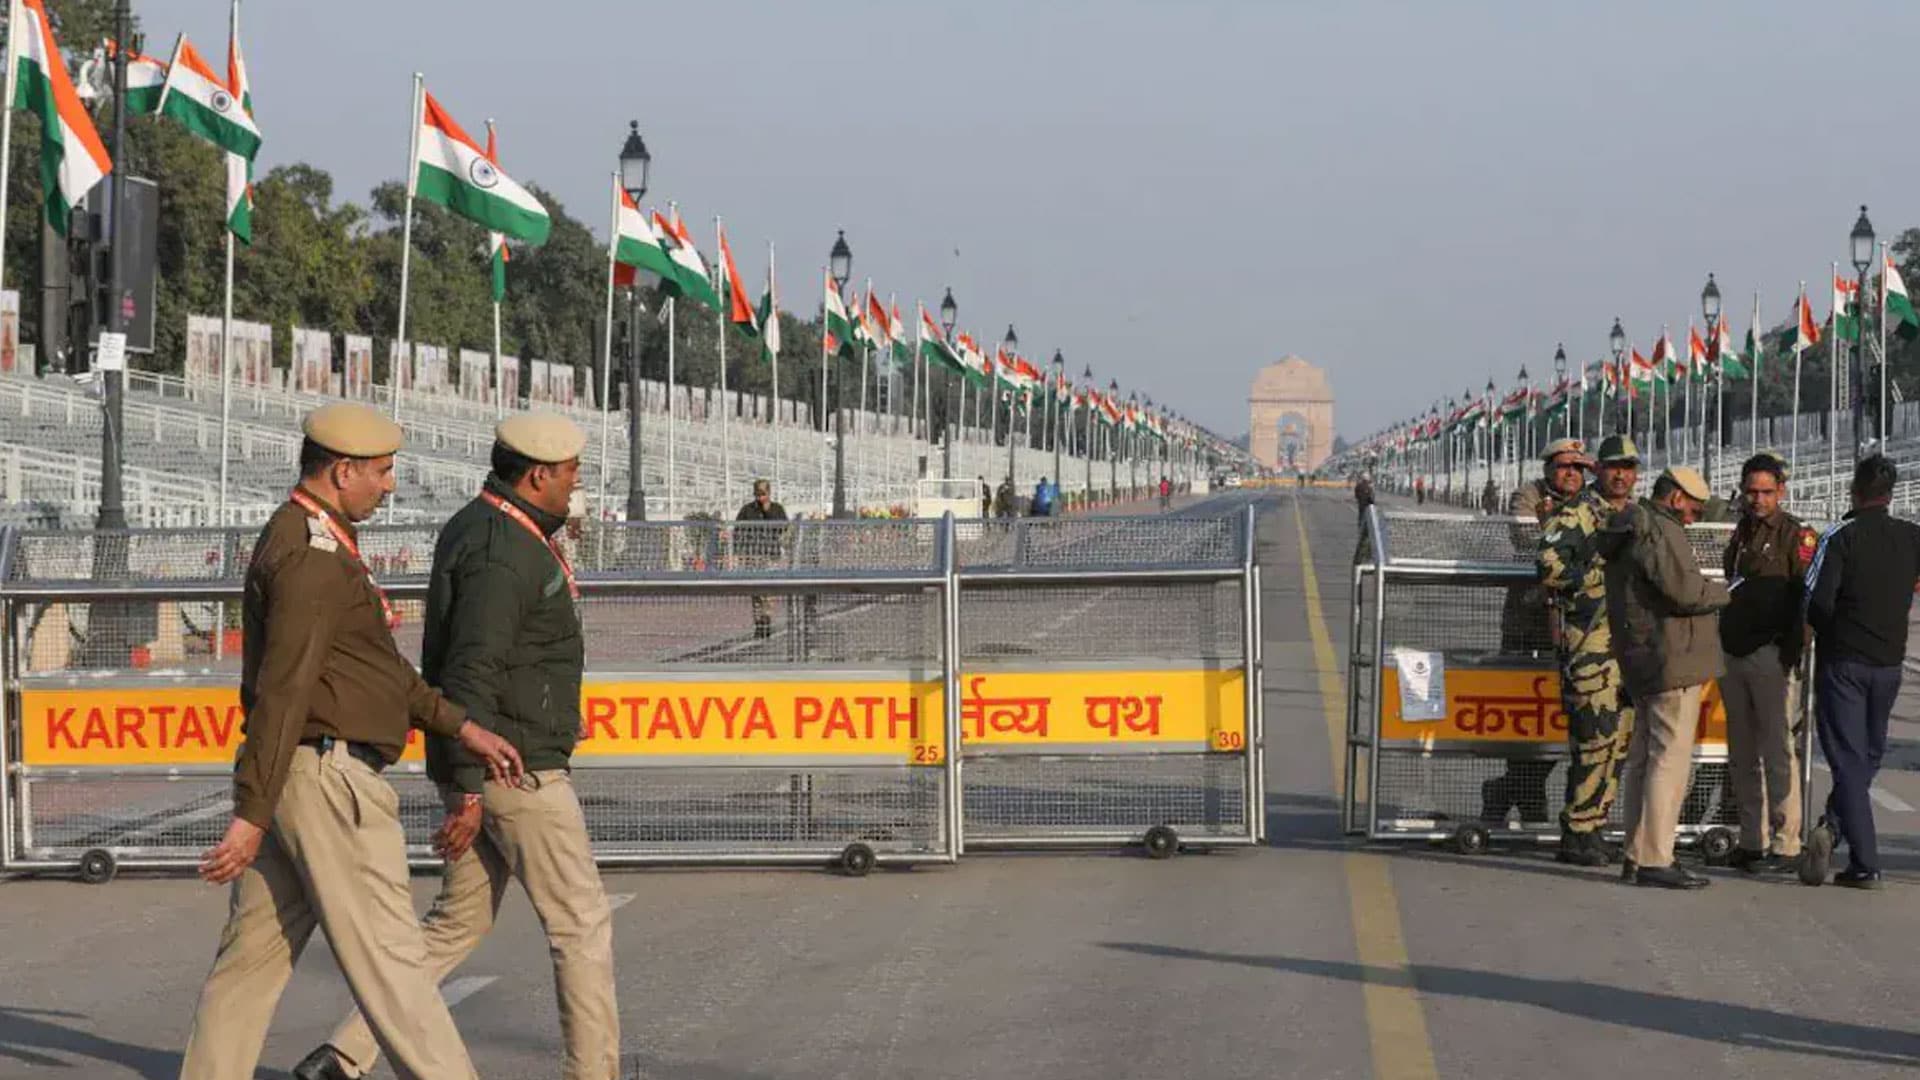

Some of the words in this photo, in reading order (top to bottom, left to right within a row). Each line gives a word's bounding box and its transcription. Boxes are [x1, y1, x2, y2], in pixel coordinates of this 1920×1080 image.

[46, 706, 244, 749] KARTAV
[580, 697, 777, 739] RTAVYA
[794, 696, 918, 739] PATH
[1084, 696, 1163, 737] पथ
[914, 745, 938, 762] 25
[1218, 732, 1241, 748] 30
